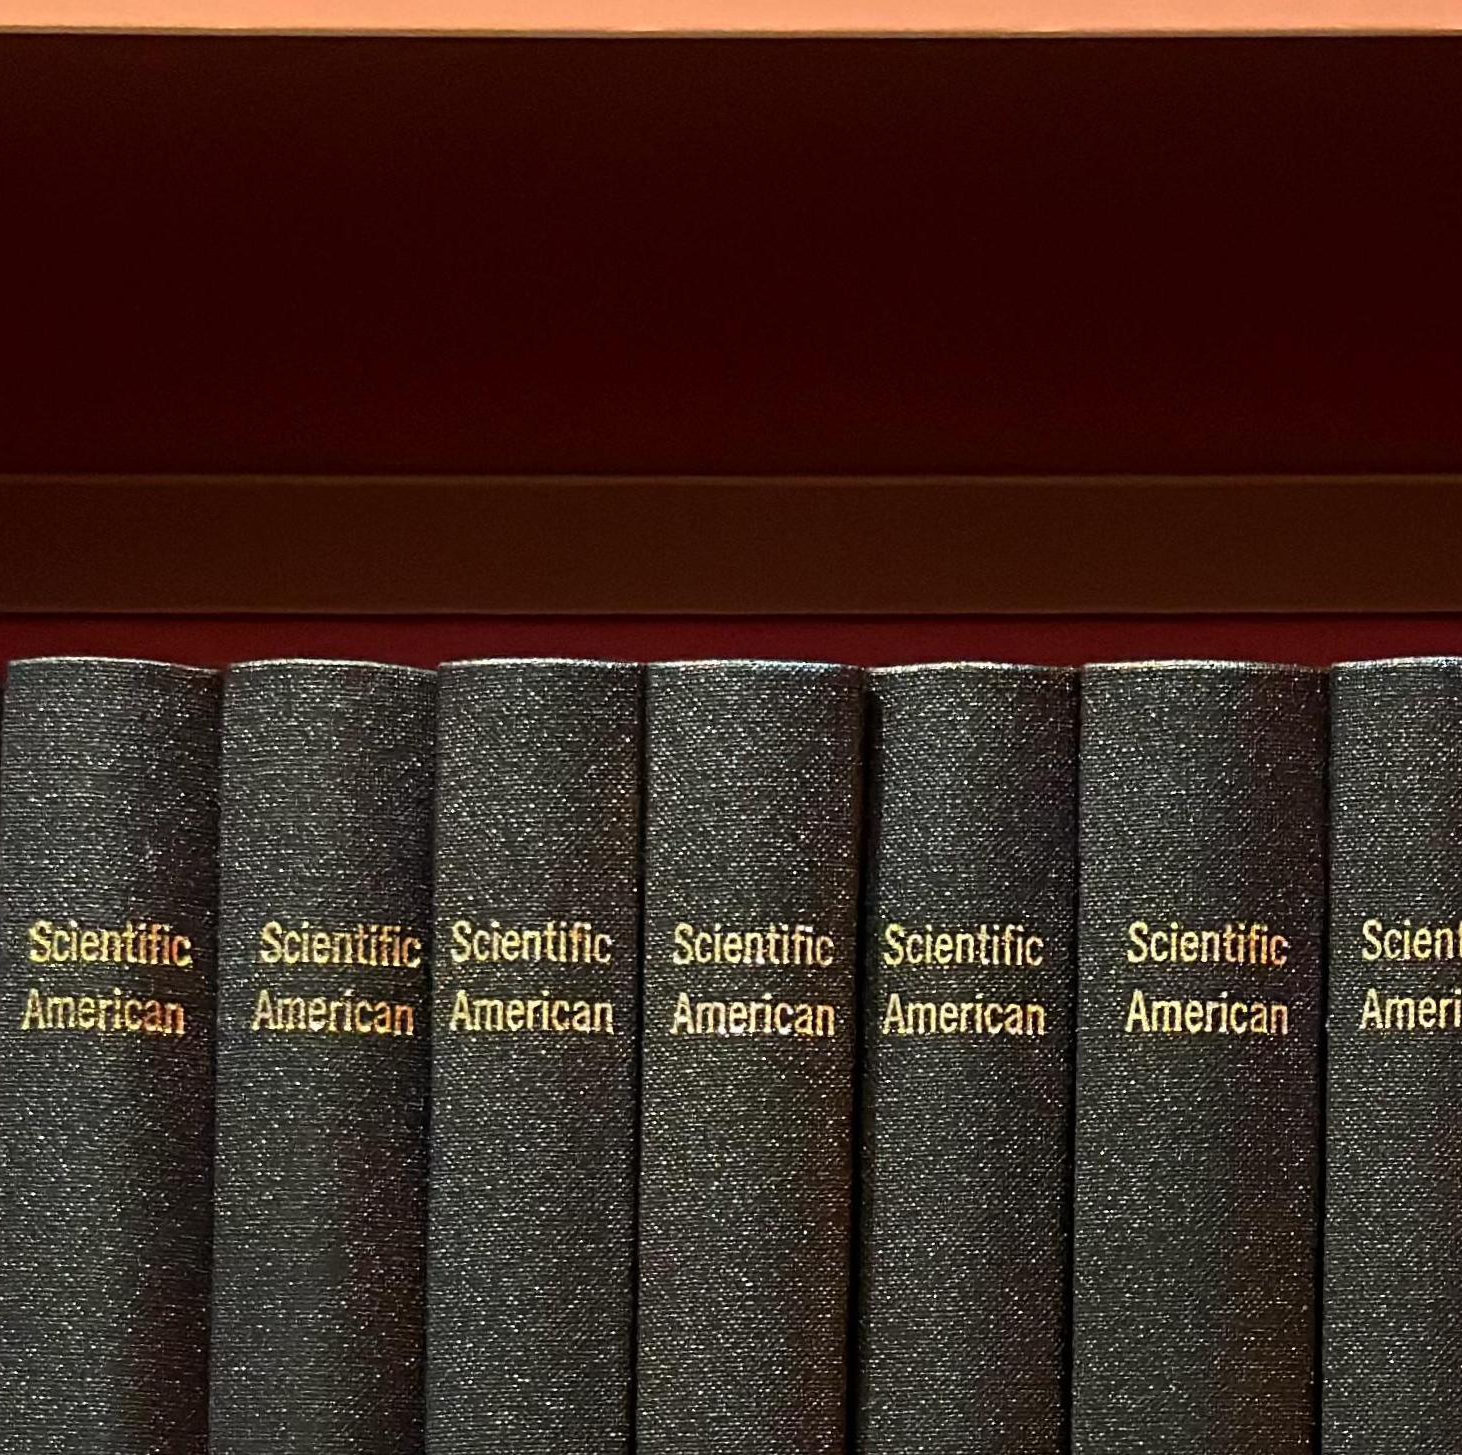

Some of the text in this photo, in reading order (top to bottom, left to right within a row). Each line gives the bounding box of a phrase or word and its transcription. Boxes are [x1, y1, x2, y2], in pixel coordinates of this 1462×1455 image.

[261, 923, 422, 968] Scientific
[676, 925, 832, 966] Scientific
[1128, 922, 1286, 967] Scientific
[253, 992, 415, 1035] American
[674, 997, 836, 1038] American
[1125, 993, 1288, 1035] American
